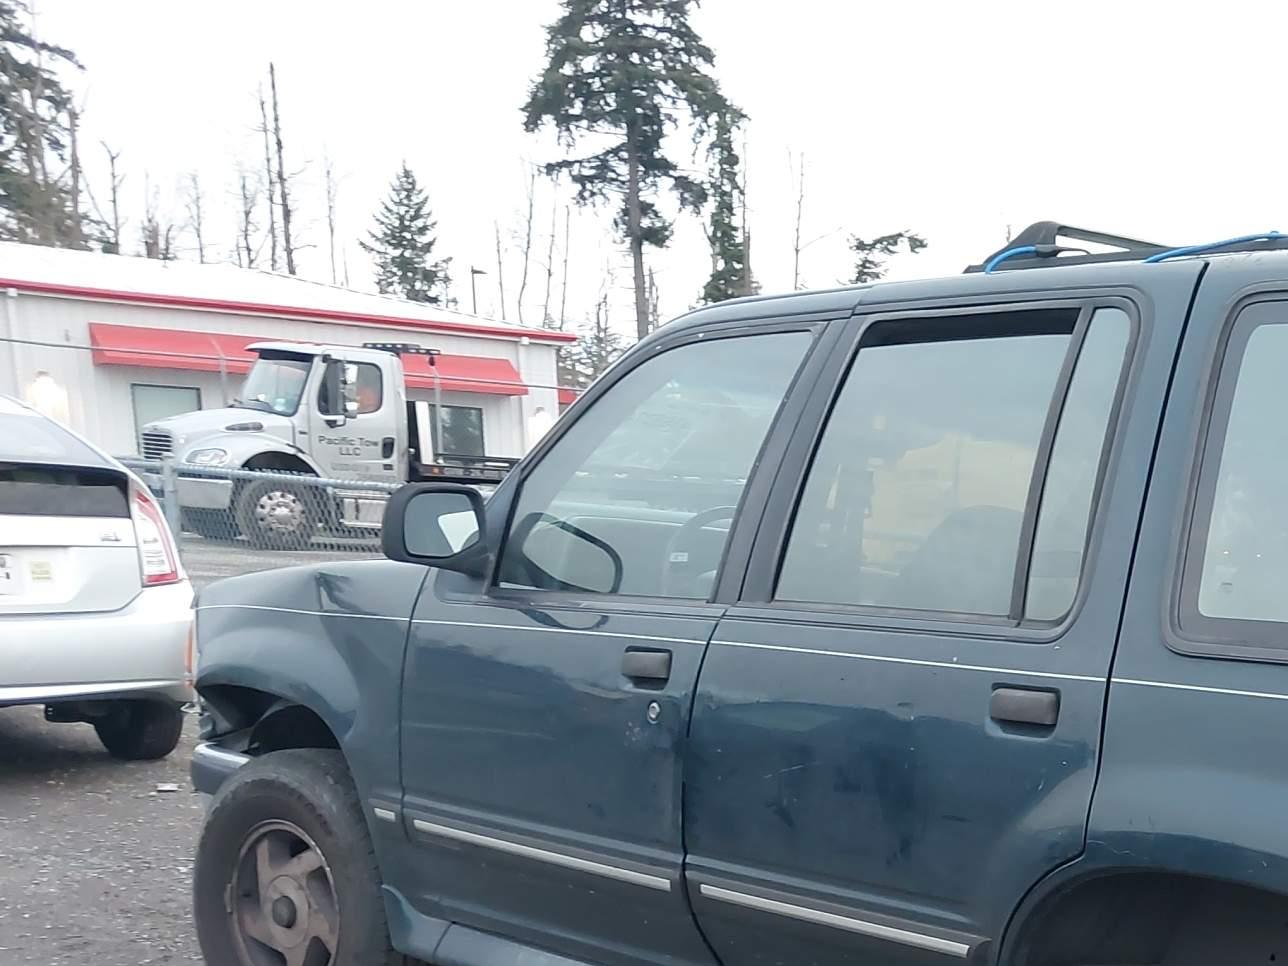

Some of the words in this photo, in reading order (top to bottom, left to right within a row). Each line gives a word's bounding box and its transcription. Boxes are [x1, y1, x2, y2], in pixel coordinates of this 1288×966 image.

[318, 435, 356, 447] Pacific
[357, 437, 379, 448] Tow
[339, 447, 361, 457] LLC
